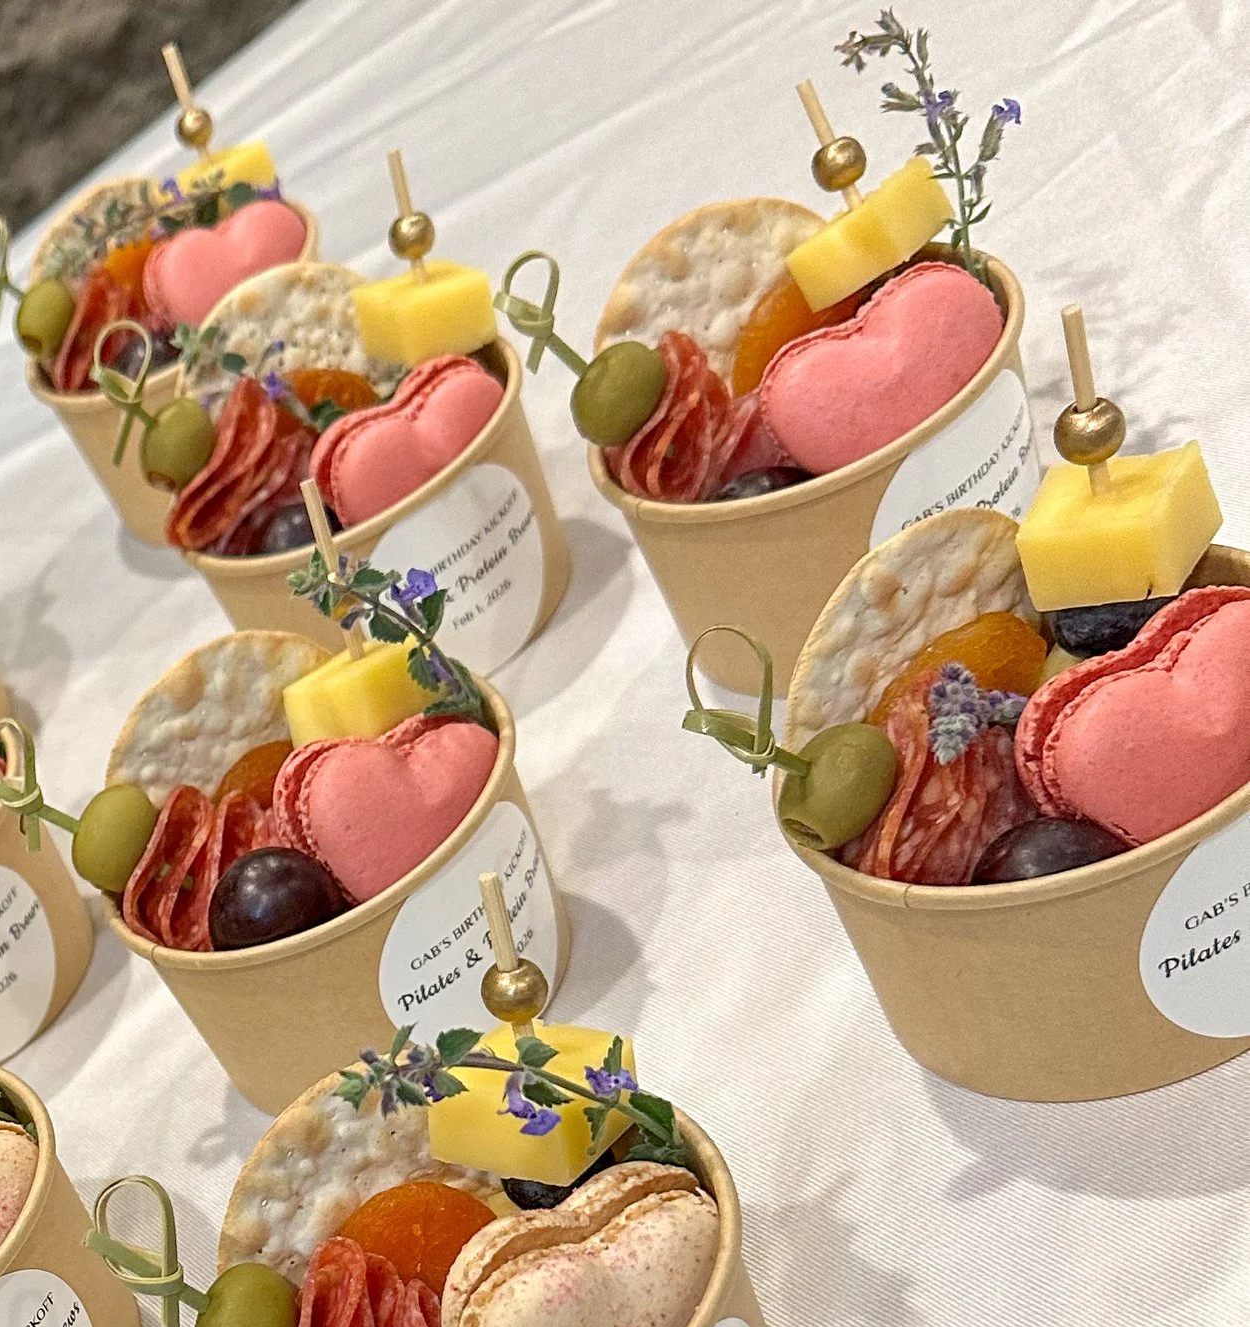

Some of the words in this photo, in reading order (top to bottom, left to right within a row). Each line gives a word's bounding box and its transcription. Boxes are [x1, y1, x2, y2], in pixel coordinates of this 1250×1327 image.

[946, 453, 999, 506] BIRTHDAY
[430, 531, 483, 575] IRTHDAY
[455, 547, 507, 593] Protein
[1185, 892, 1239, 930] GAB'S
[410, 936, 452, 971] GAB'S
[452, 903, 487, 941] BIRTH
[516, 928, 535, 953] 026
[1158, 929, 1241, 979] Pilates
[397, 968, 462, 1012] Pilates
[465, 948, 483, 968] &
